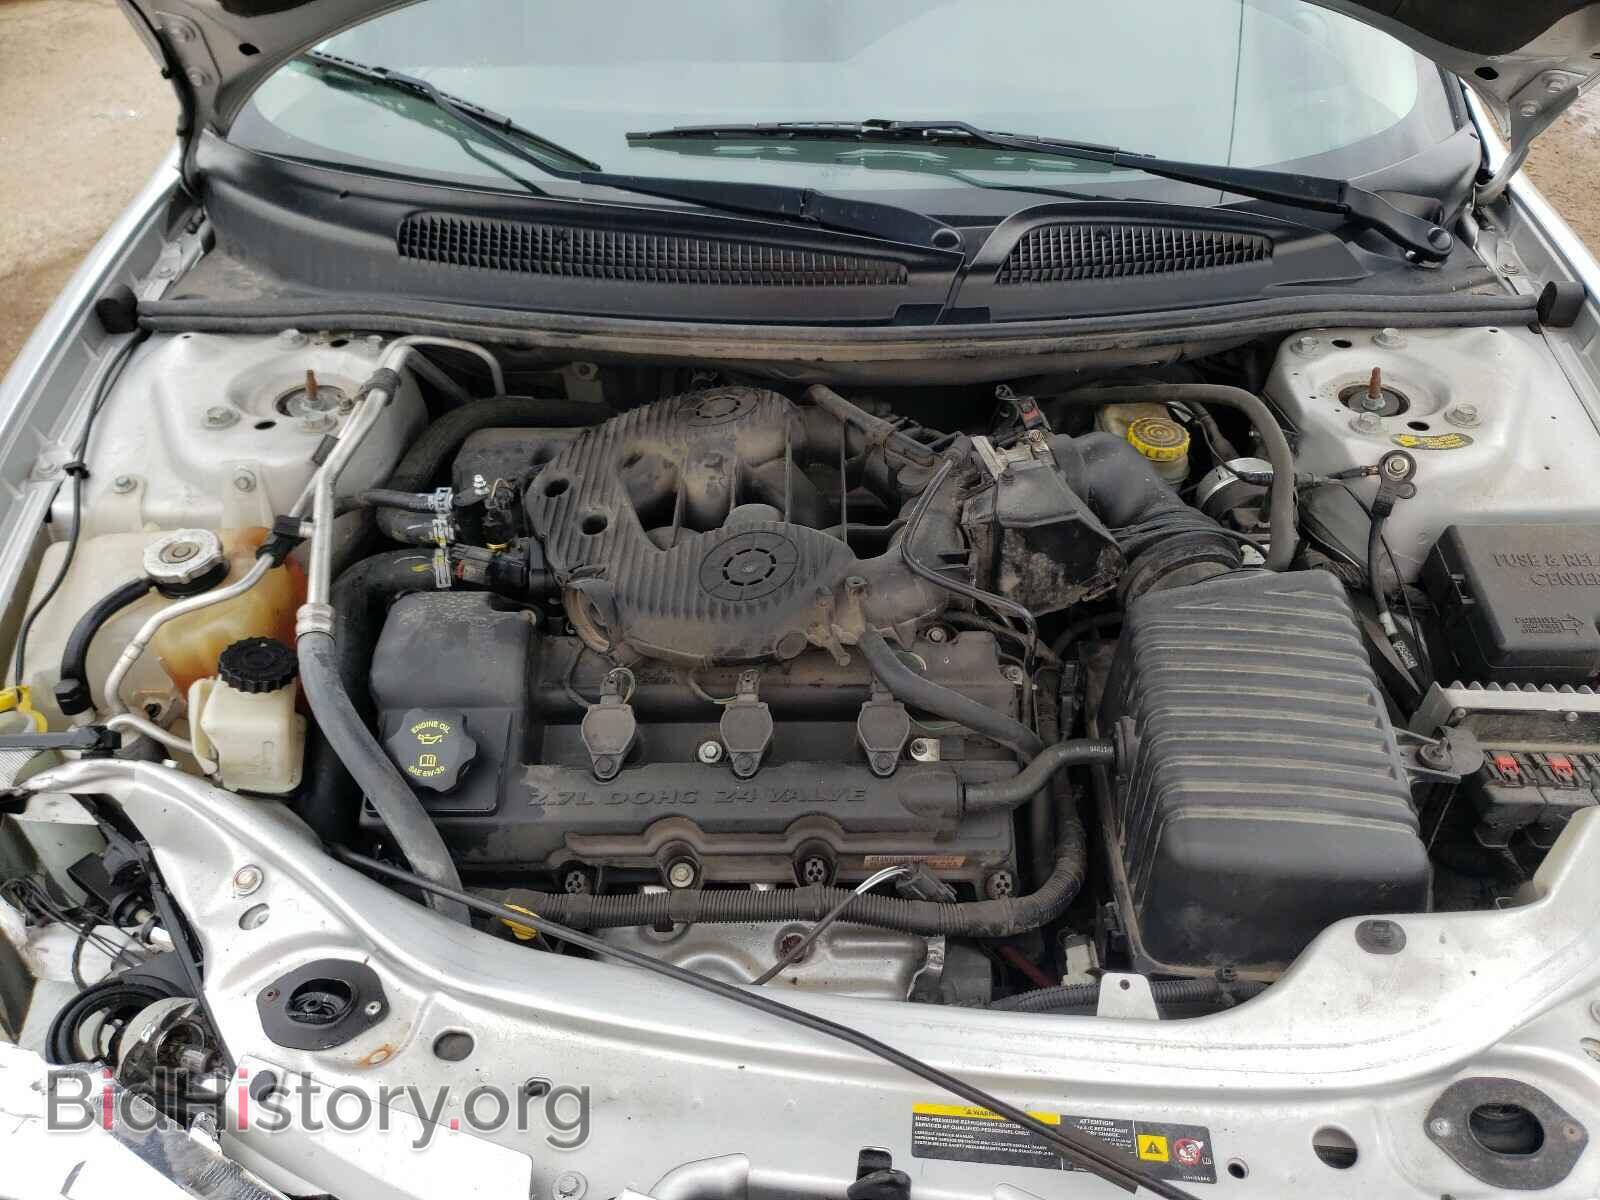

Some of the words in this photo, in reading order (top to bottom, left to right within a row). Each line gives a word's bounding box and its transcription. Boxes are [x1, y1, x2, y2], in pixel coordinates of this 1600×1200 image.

[1489, 552, 1538, 568] FUSE
[410, 720, 439, 734] ENGINE
[439, 722, 450, 734] OIL
[408, 766, 423, 776] SAE
[603, 790, 699, 806] DOHC
[766, 787, 868, 803] VALVE
